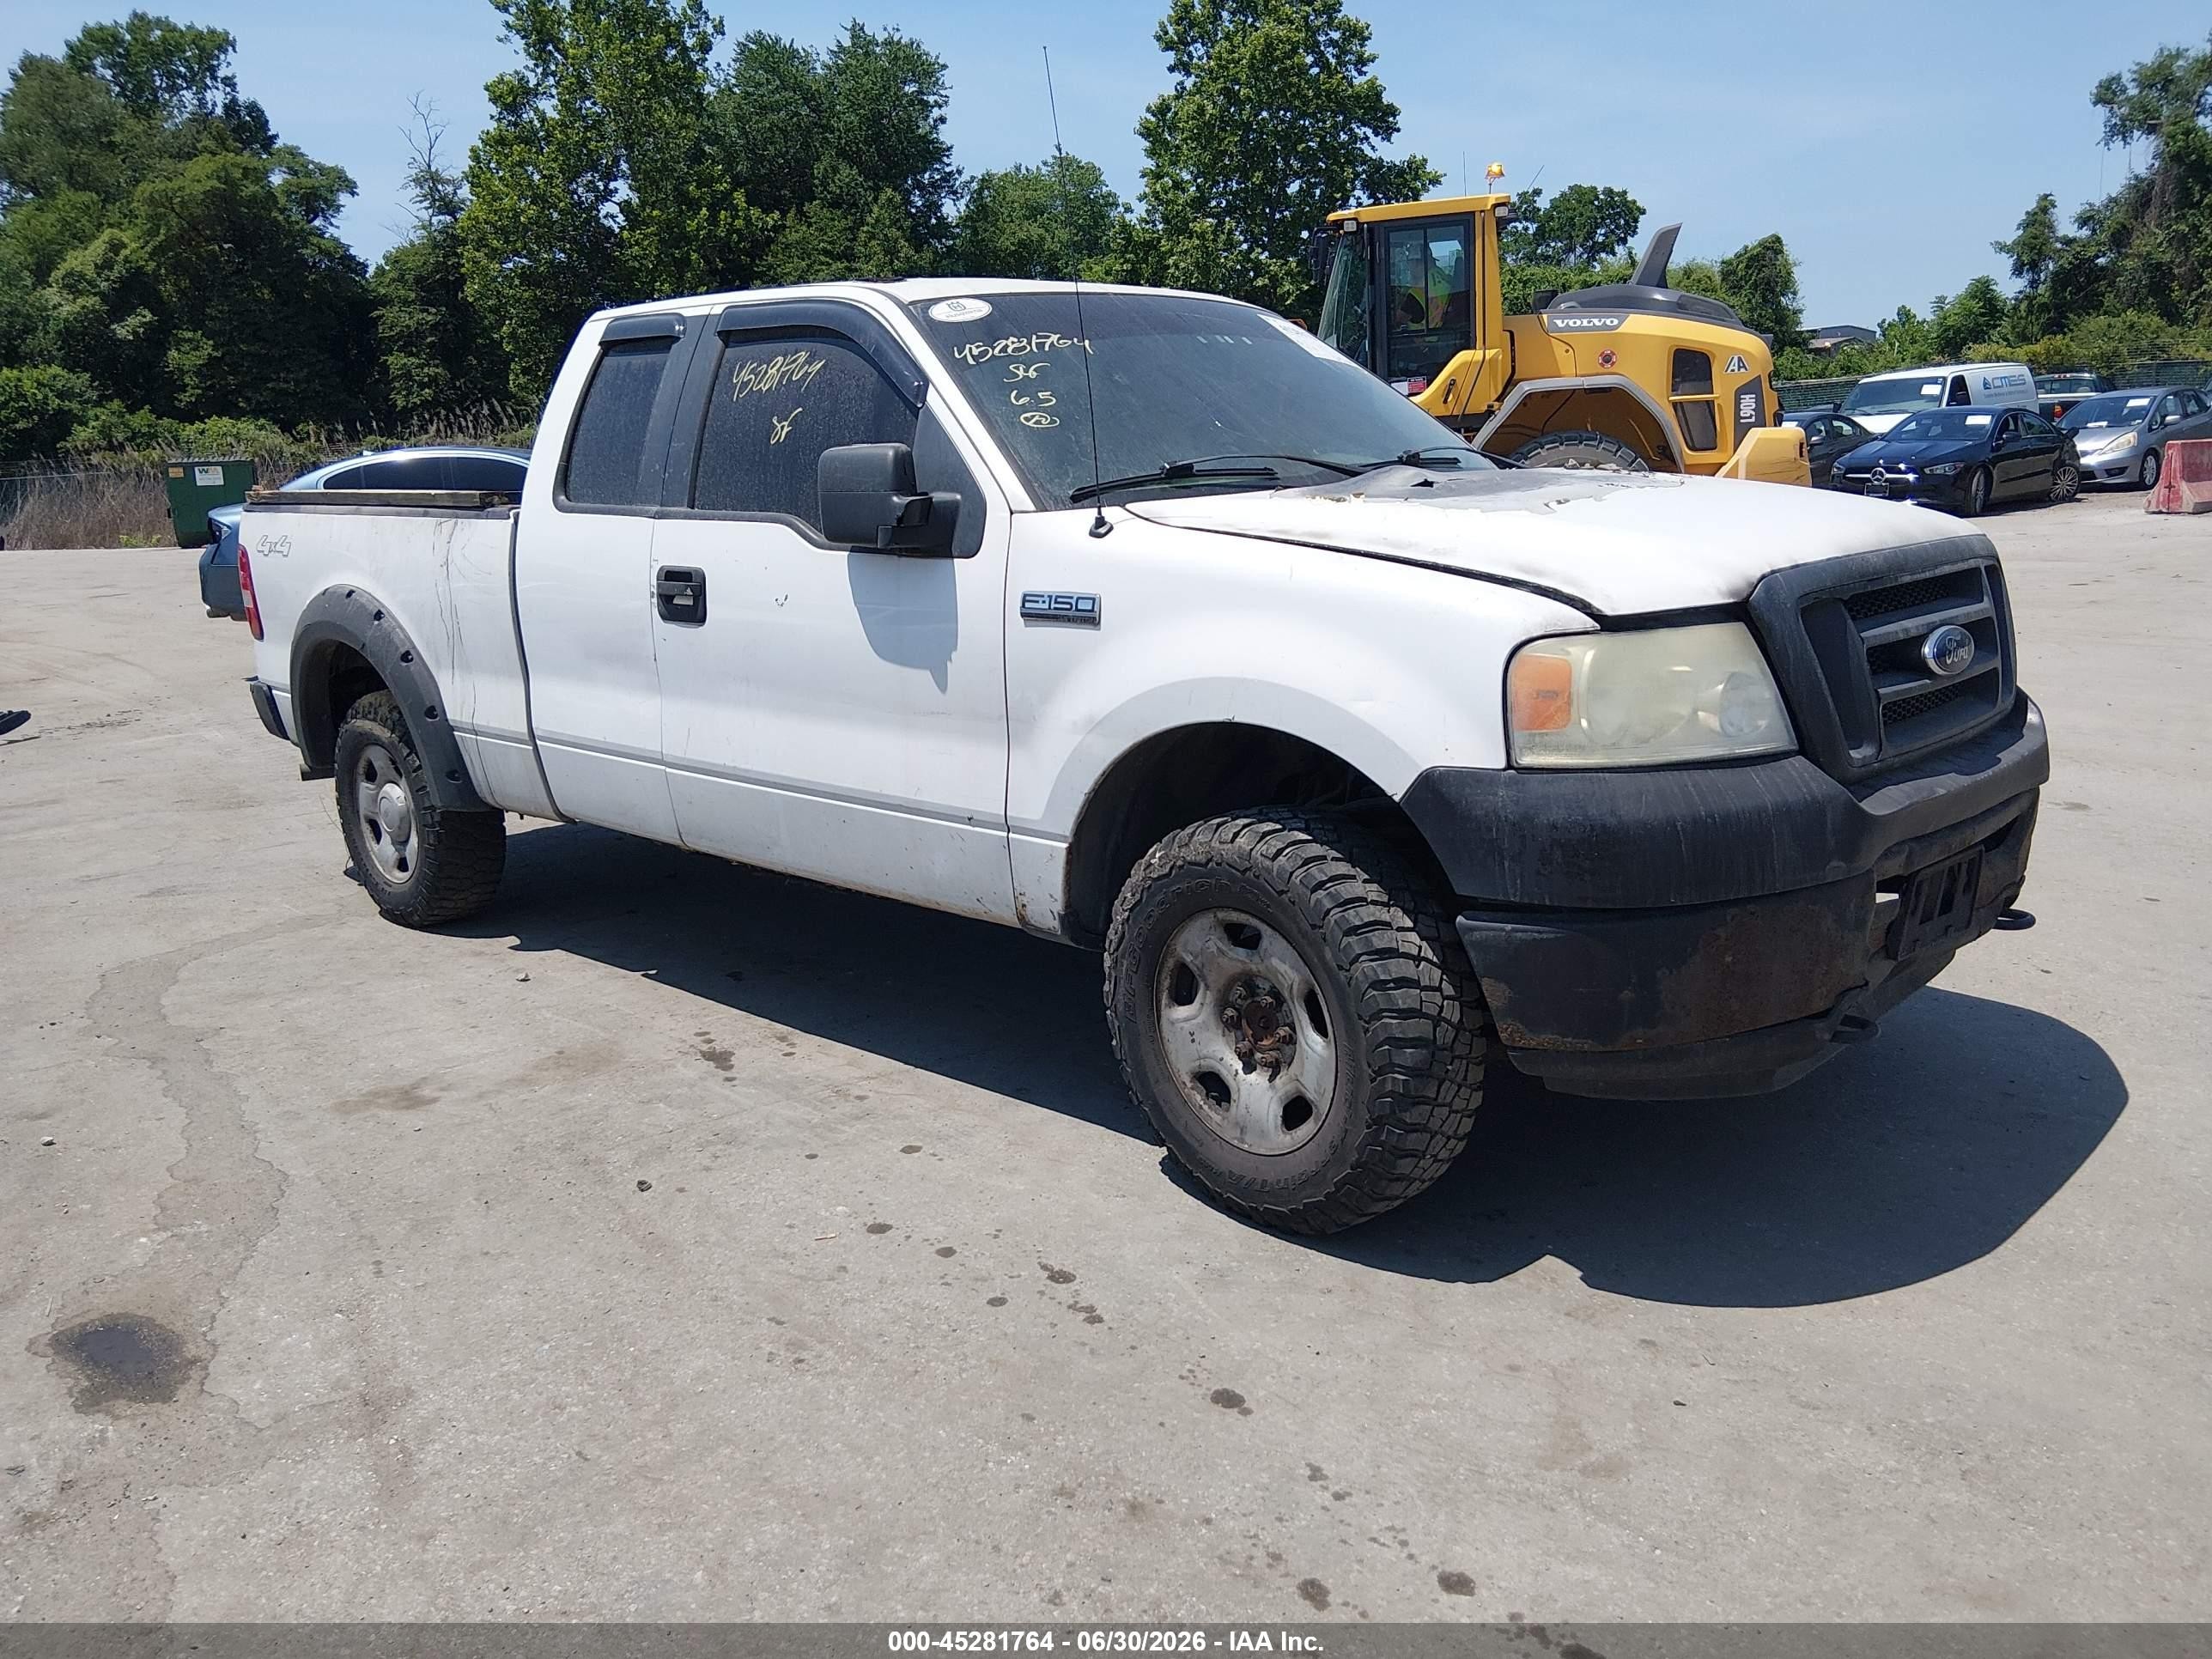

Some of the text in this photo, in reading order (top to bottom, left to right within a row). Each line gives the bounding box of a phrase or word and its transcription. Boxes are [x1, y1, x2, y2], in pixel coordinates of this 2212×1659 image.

[1553, 318, 1619, 327] VOLVO
[953, 331, 1094, 365] 45281764
[1010, 389, 1057, 407] 6.5
[1739, 394, 1756, 422] L90H
[256, 534, 292, 558] 4x4
[1944, 634, 1970, 665] Ford
